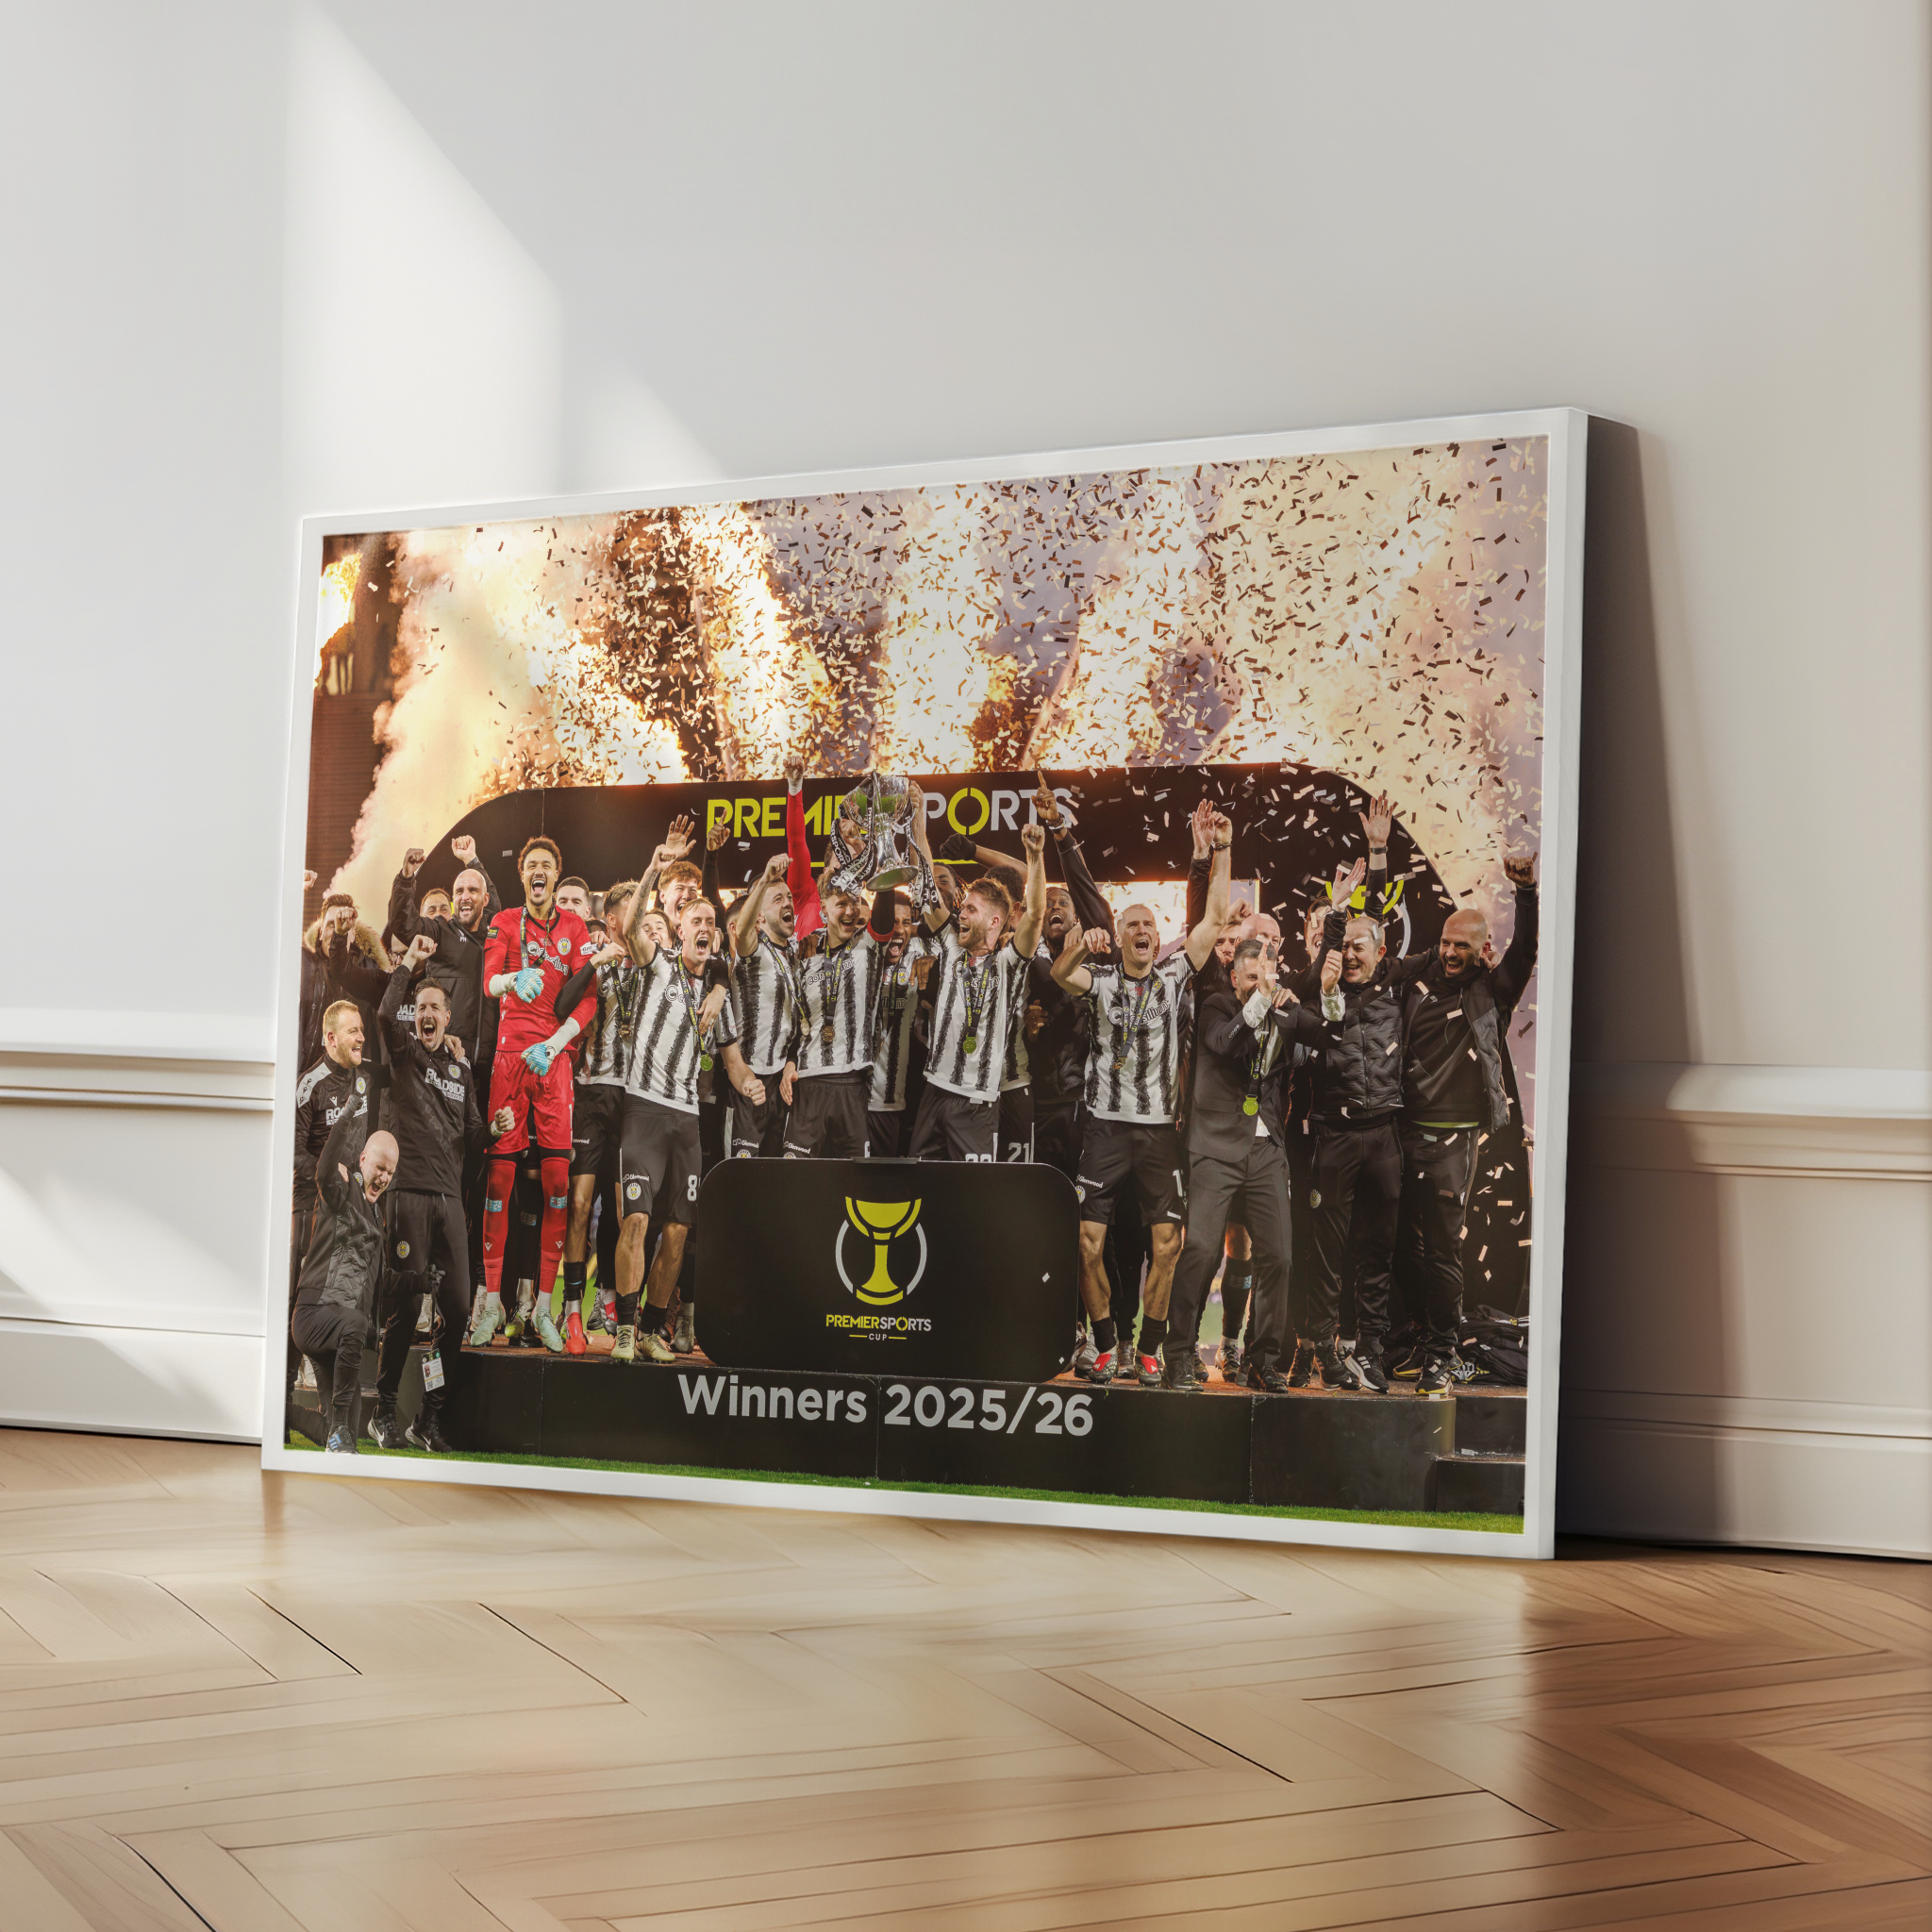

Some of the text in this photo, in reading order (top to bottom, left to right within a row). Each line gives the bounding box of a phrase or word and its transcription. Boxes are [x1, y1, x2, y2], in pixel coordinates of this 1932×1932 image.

[1008, 1142, 1030, 1163] 21
[687, 1174, 698, 1202] 8
[868, 1333, 888, 1341] CUP
[677, 1374, 1093, 1437] Winners 2025/26
